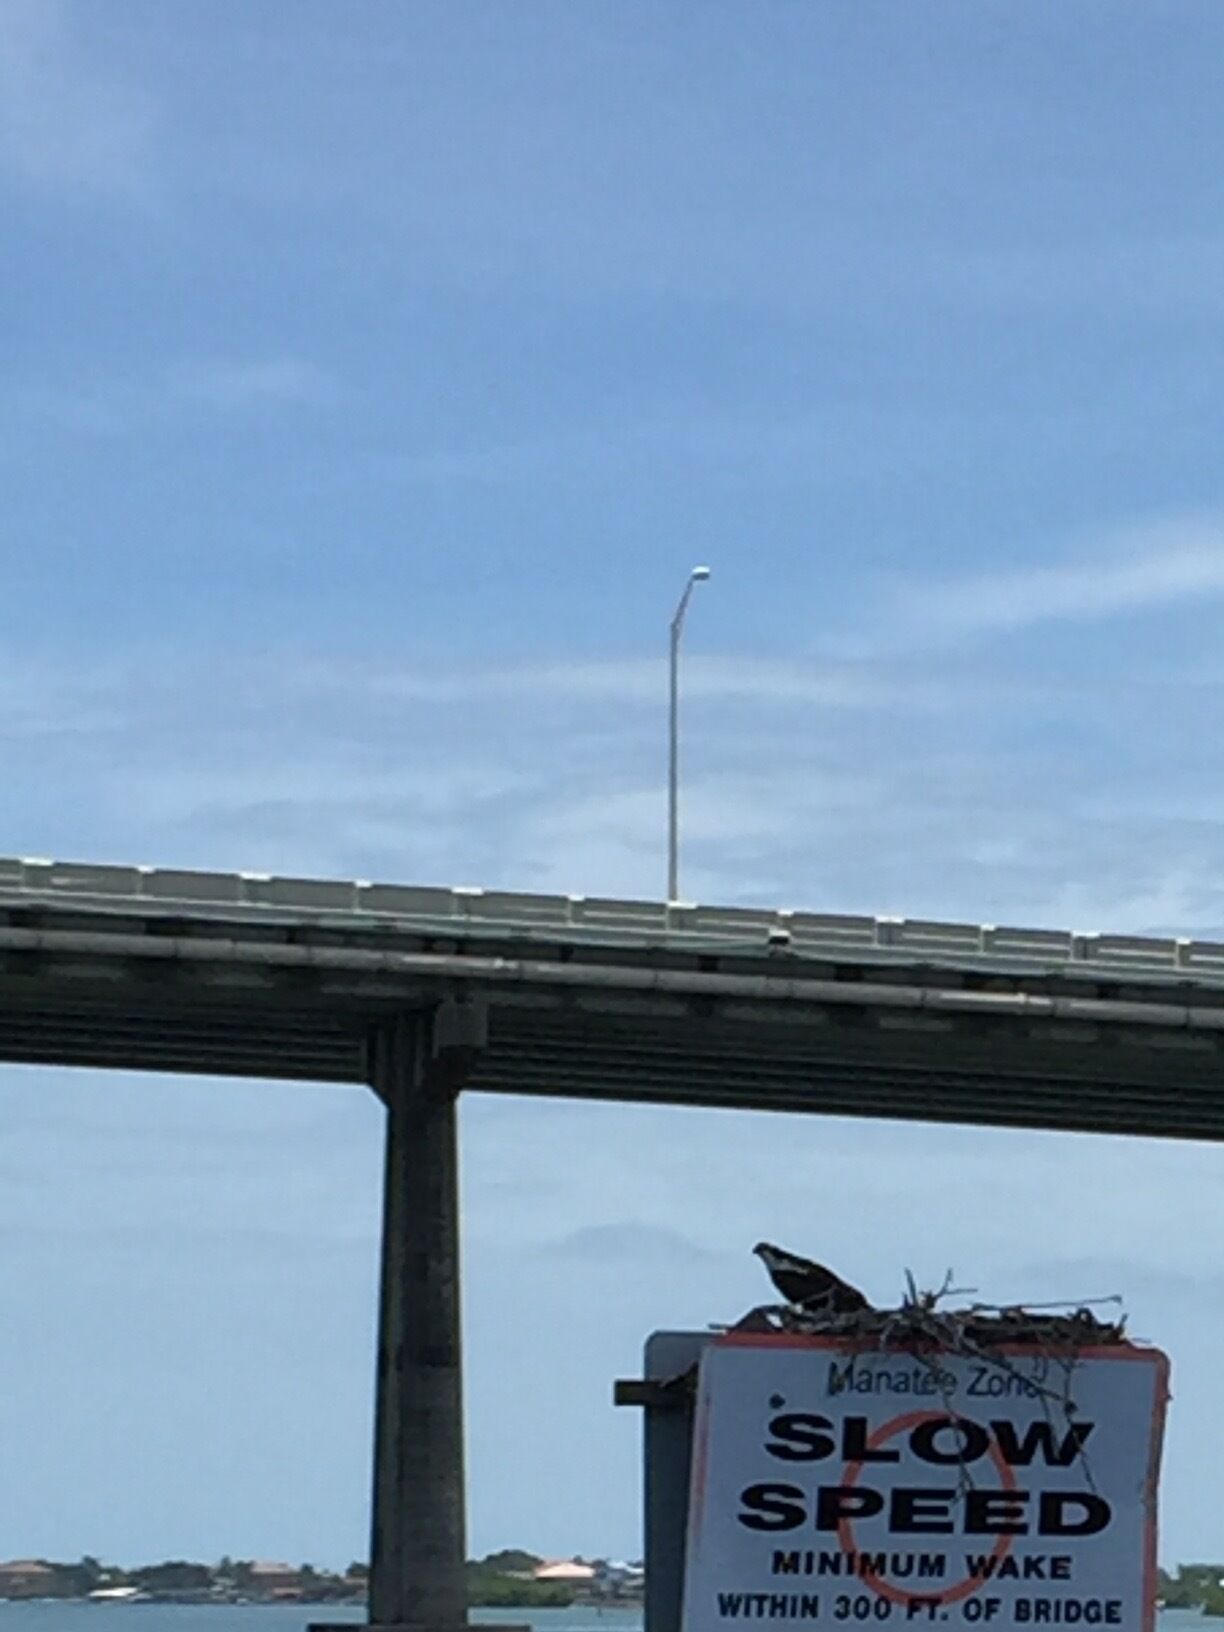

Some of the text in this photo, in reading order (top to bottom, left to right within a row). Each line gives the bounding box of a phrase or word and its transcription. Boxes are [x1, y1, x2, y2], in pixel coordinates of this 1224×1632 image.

[765, 1412, 1095, 1466] SLOW
[737, 1482, 1112, 1536] SPEED
[771, 1550, 1073, 1580] MINIMUM WAKE
[717, 1593, 1122, 1624] WITHIN 300 FT. OF BRIDGE
